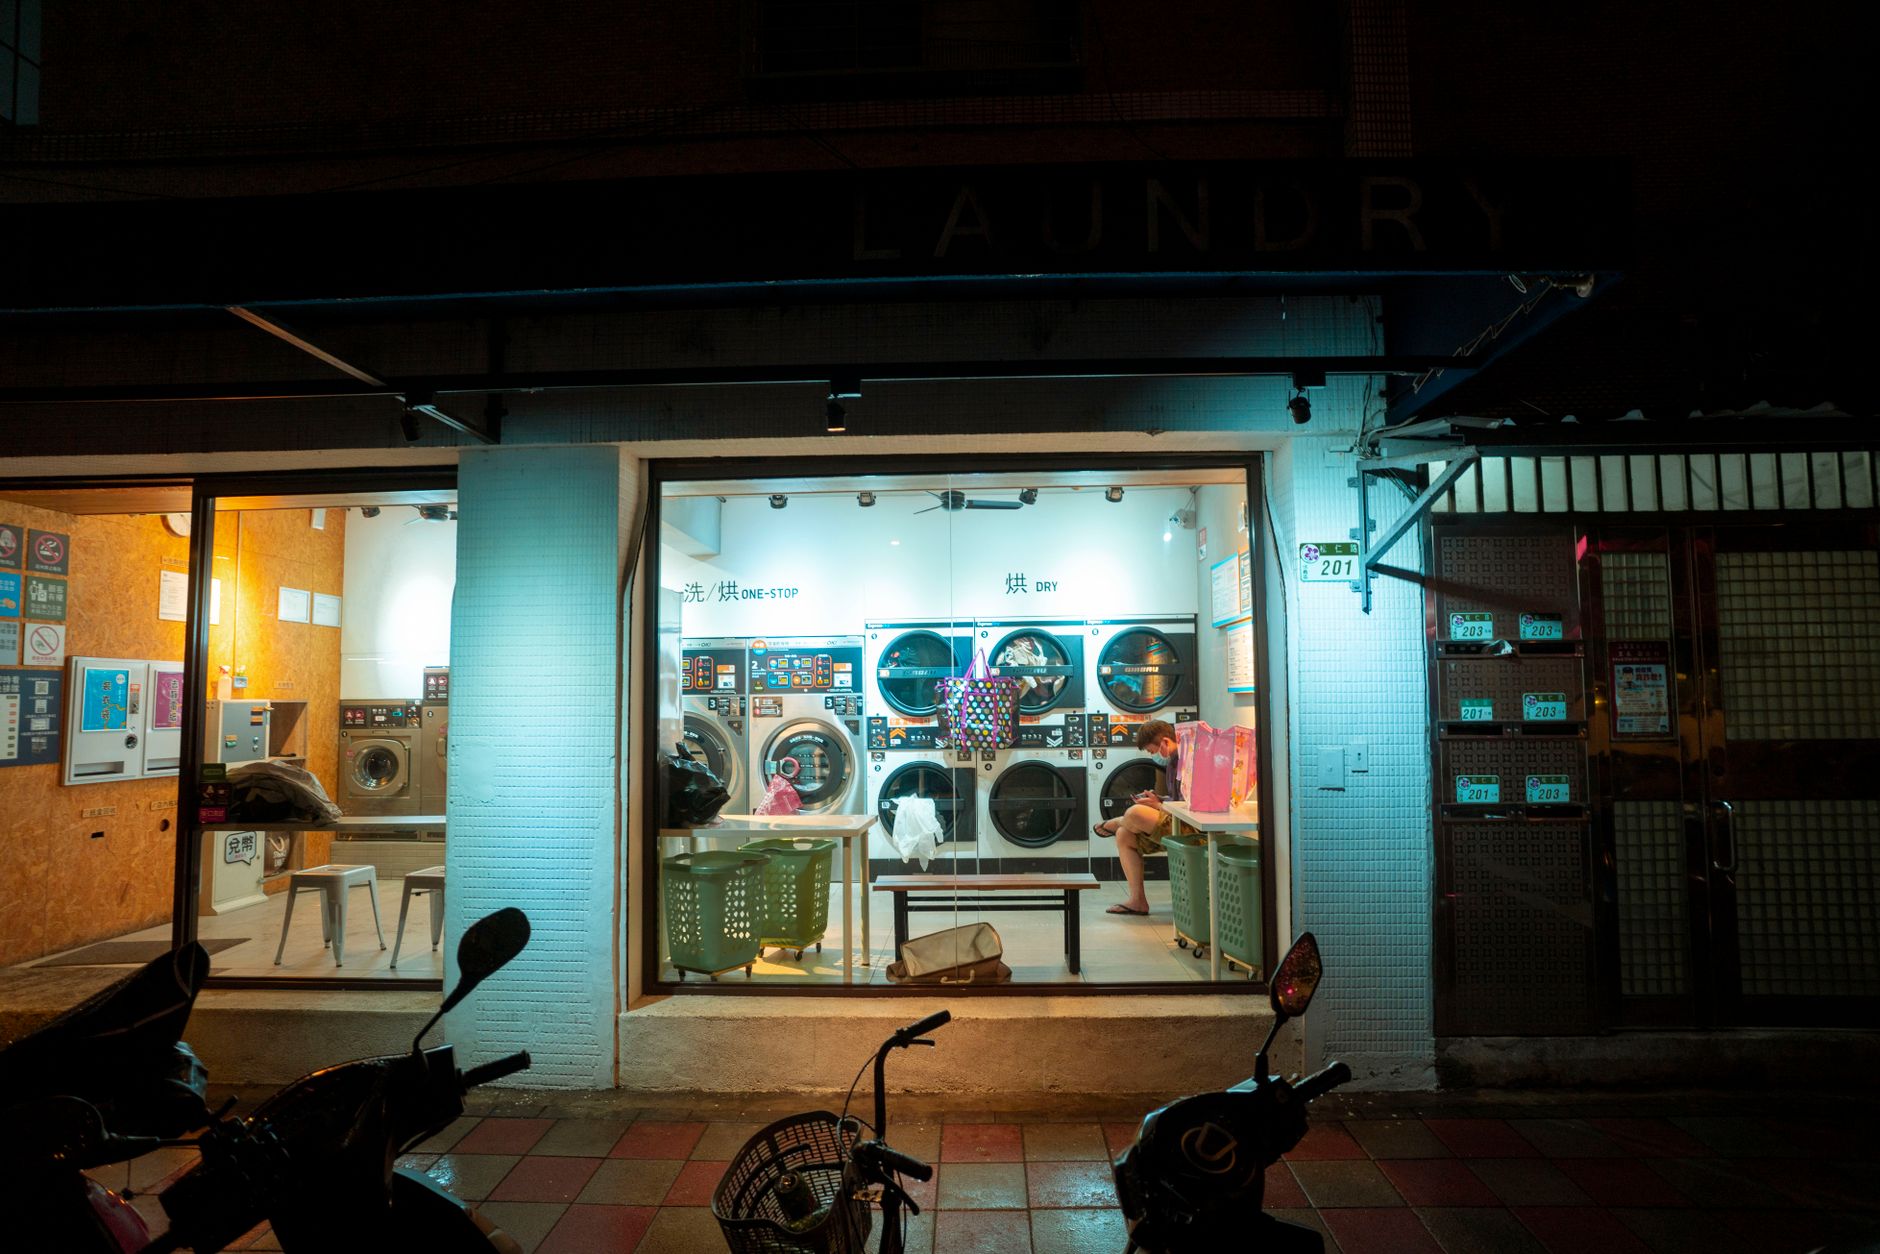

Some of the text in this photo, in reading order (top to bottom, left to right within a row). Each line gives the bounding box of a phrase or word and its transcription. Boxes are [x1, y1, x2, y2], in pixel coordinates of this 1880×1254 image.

[851, 175, 1505, 262] LAUNDRY
[1321, 559, 1352, 576] 201
[1005, 572, 1058, 595] 烘 DRY
[684, 580, 799, 603] 洗/烘 ONE-STOP
[1462, 625, 1484, 637] 203
[1532, 625, 1553, 637] 203
[751, 660, 758, 669] 2
[709, 700, 716, 708] 3
[826, 699, 833, 707] 3
[1462, 708, 1484, 720] 201
[1535, 706, 1556, 718] 203
[1467, 789, 1489, 800] 201
[1538, 789, 1560, 800] 203
